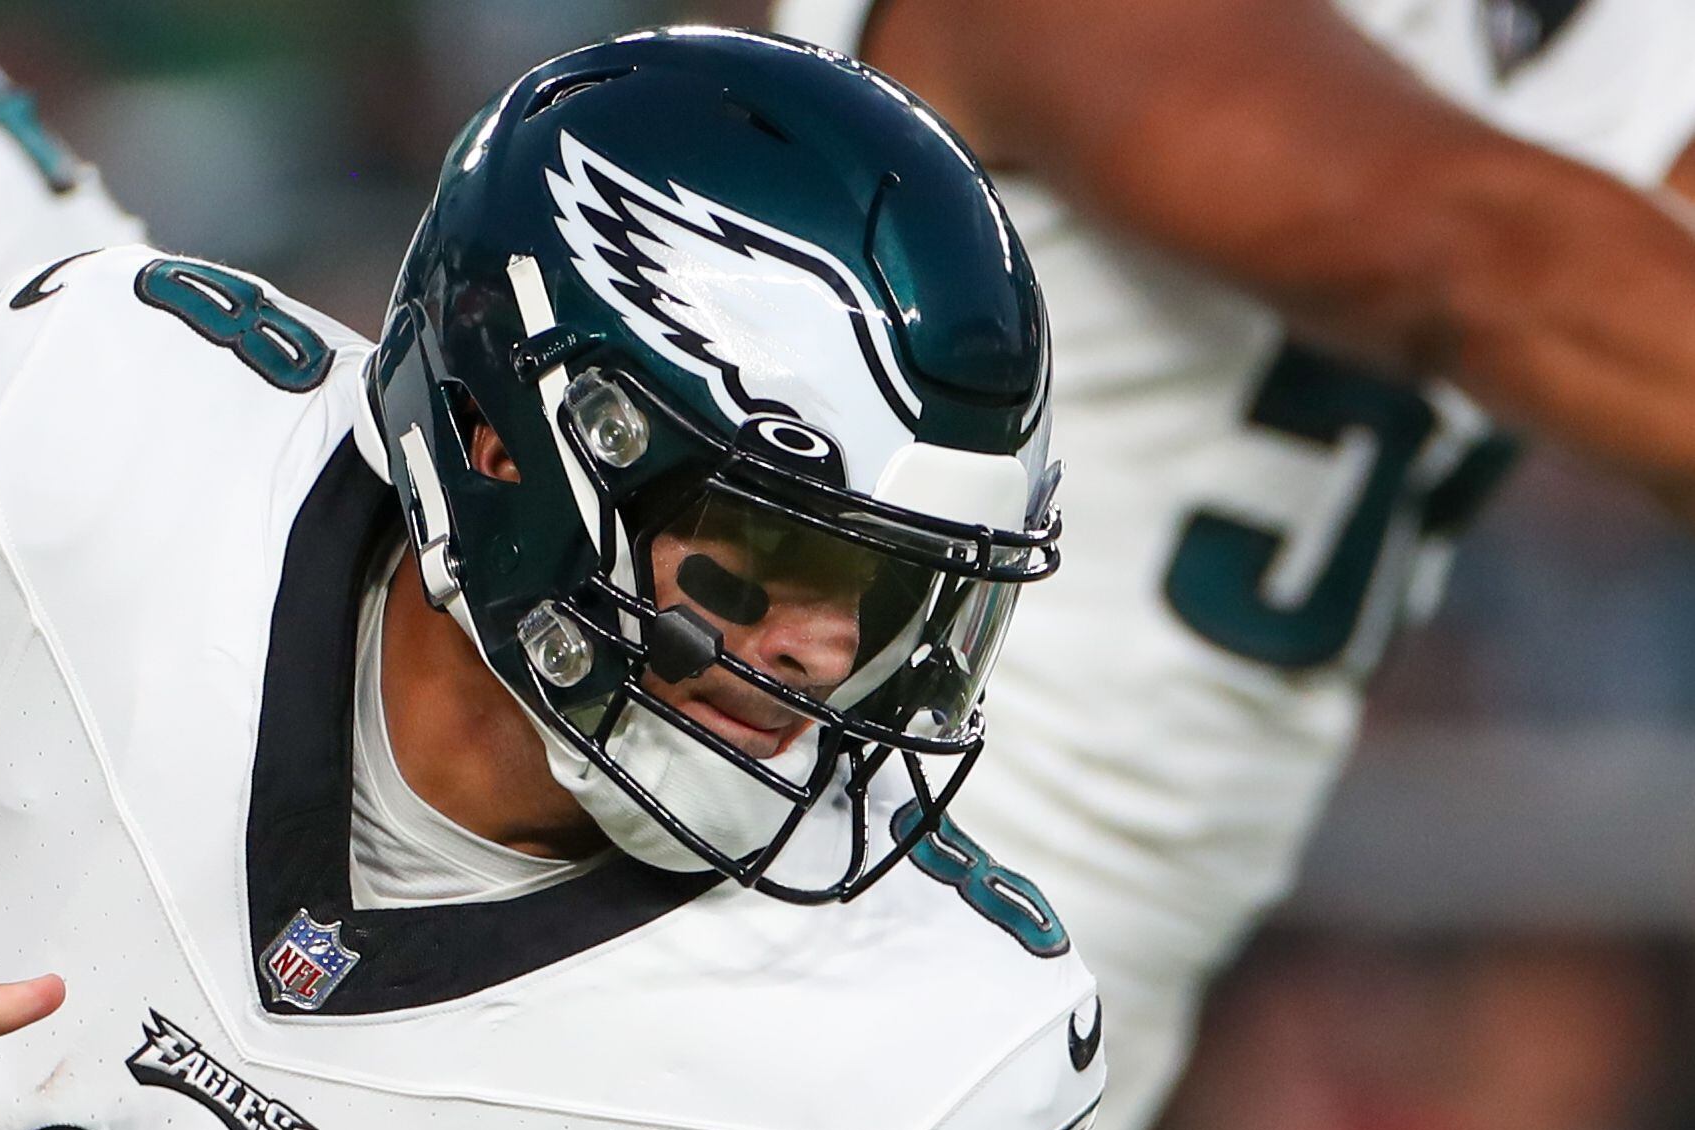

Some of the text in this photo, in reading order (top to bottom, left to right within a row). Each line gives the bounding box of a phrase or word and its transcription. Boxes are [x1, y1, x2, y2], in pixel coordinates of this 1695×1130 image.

[134, 258, 336, 394] 8
[889, 796, 1071, 958] 8
[270, 944, 325, 999] NFL
